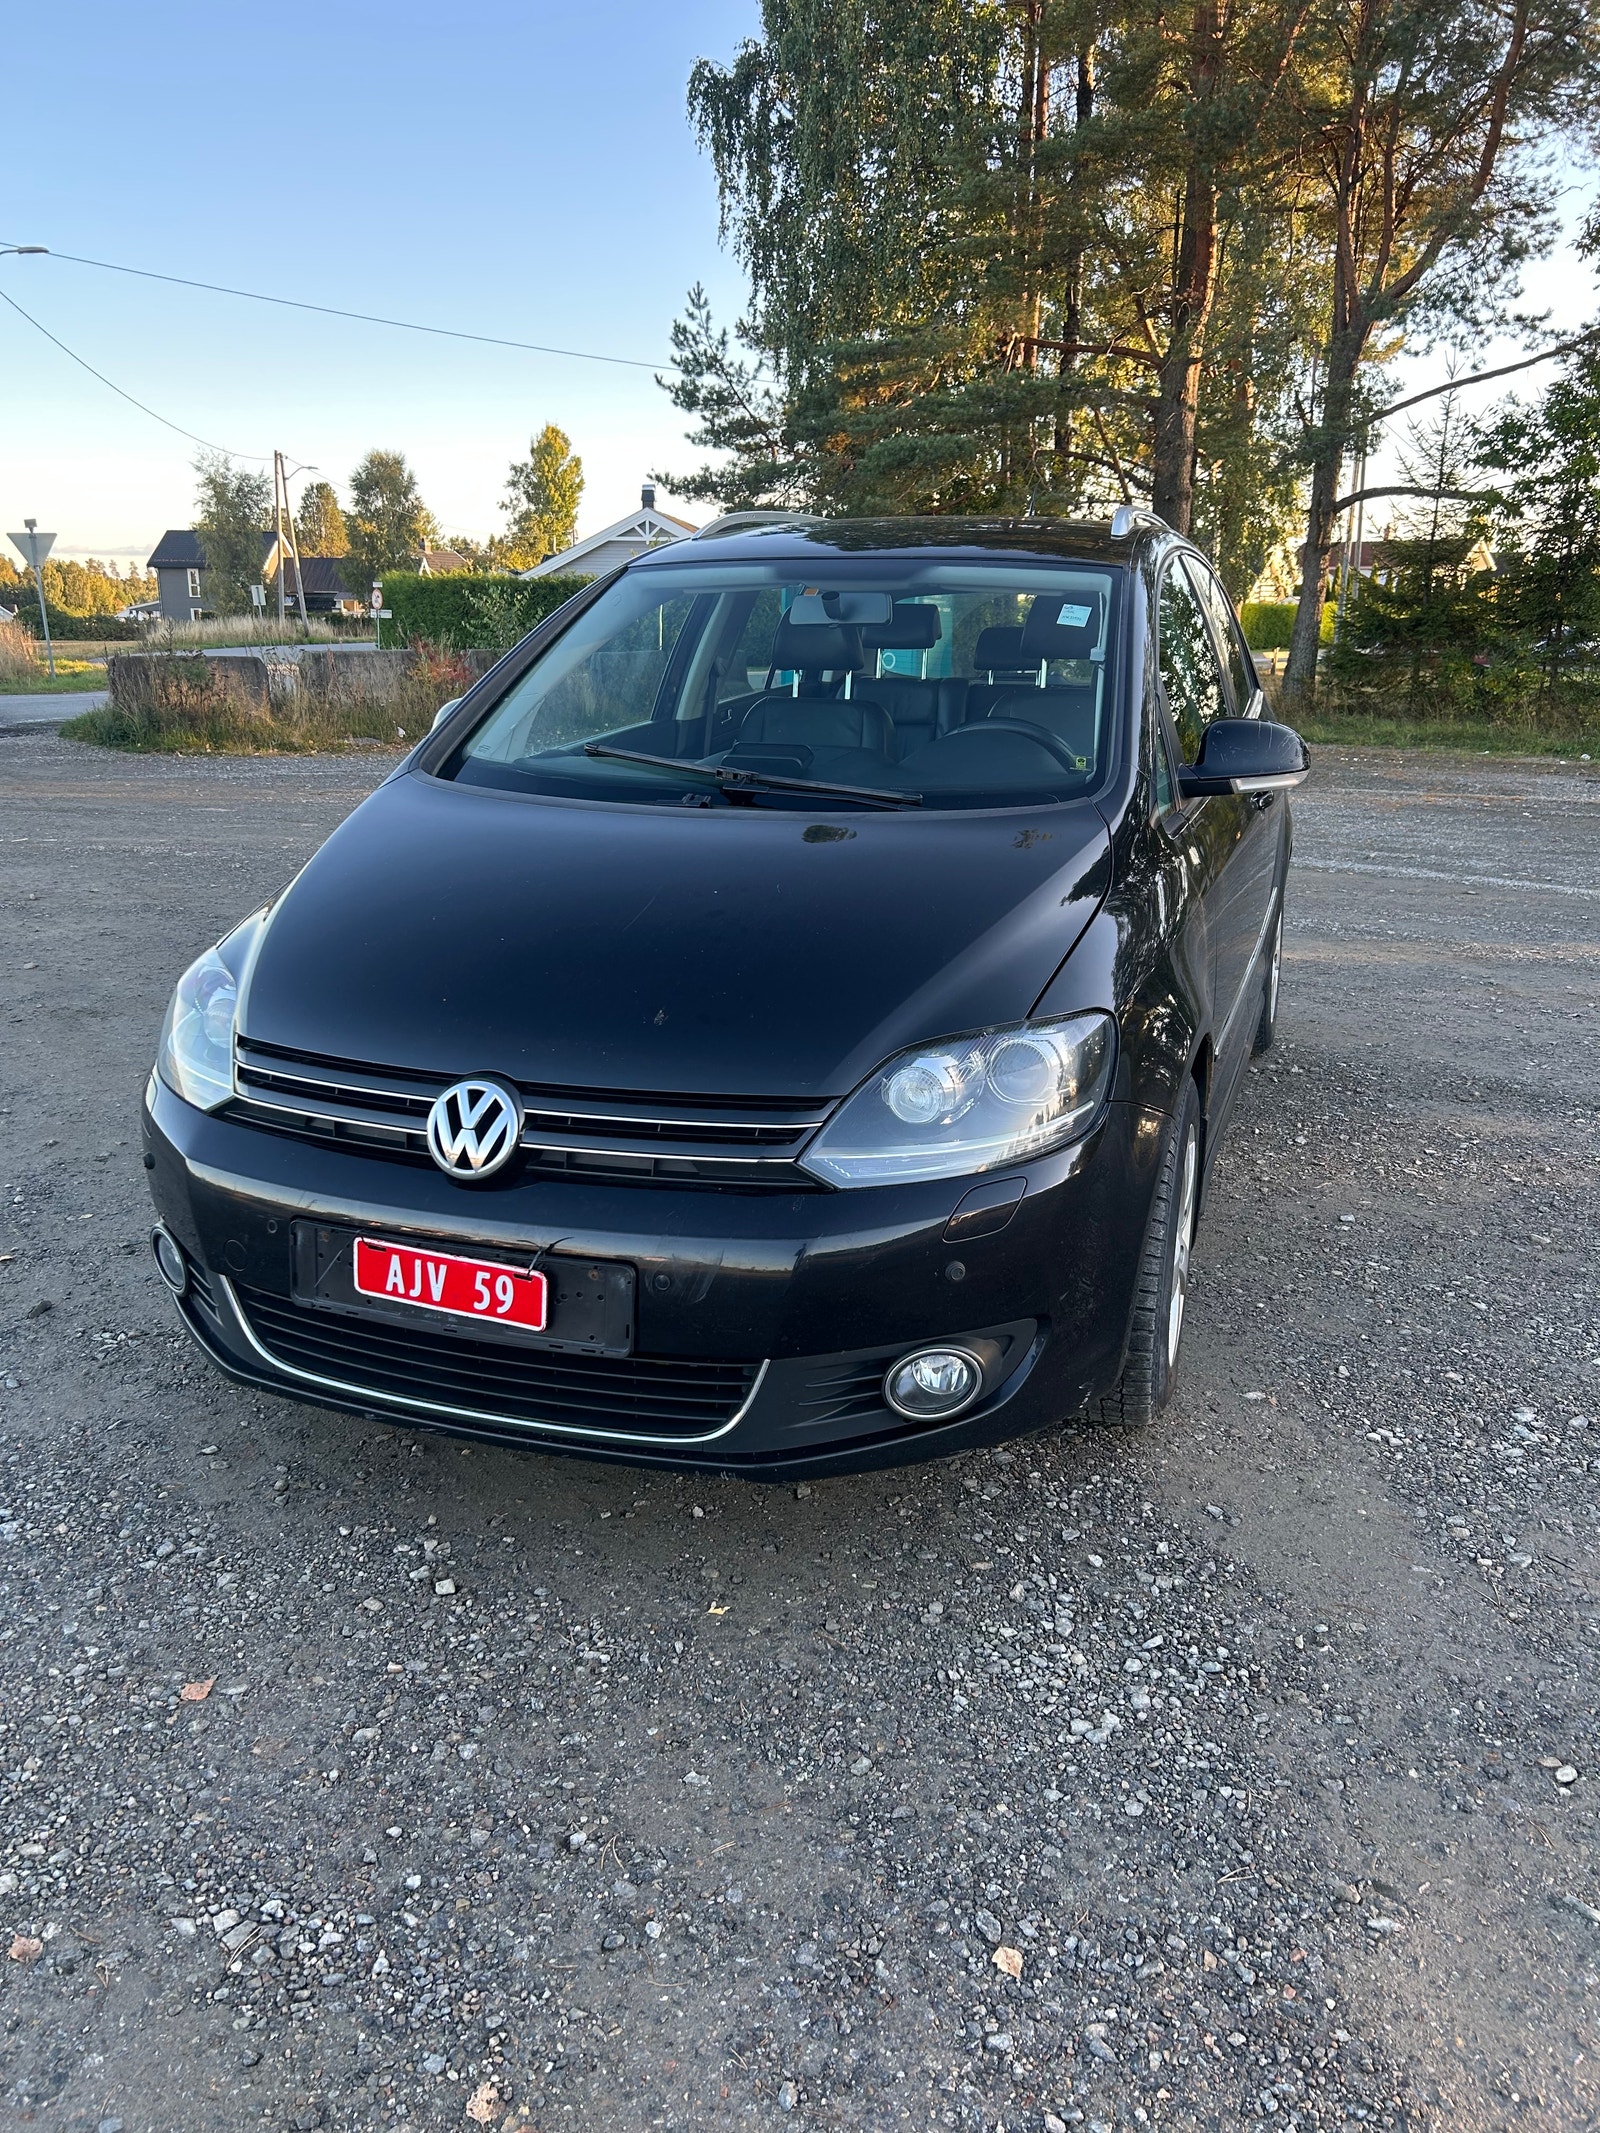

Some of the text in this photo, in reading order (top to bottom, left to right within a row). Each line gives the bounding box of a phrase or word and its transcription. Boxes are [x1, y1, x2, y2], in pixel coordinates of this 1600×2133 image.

[426, 1080, 519, 1180] VW
[385, 1254, 515, 1314] AJV 59
